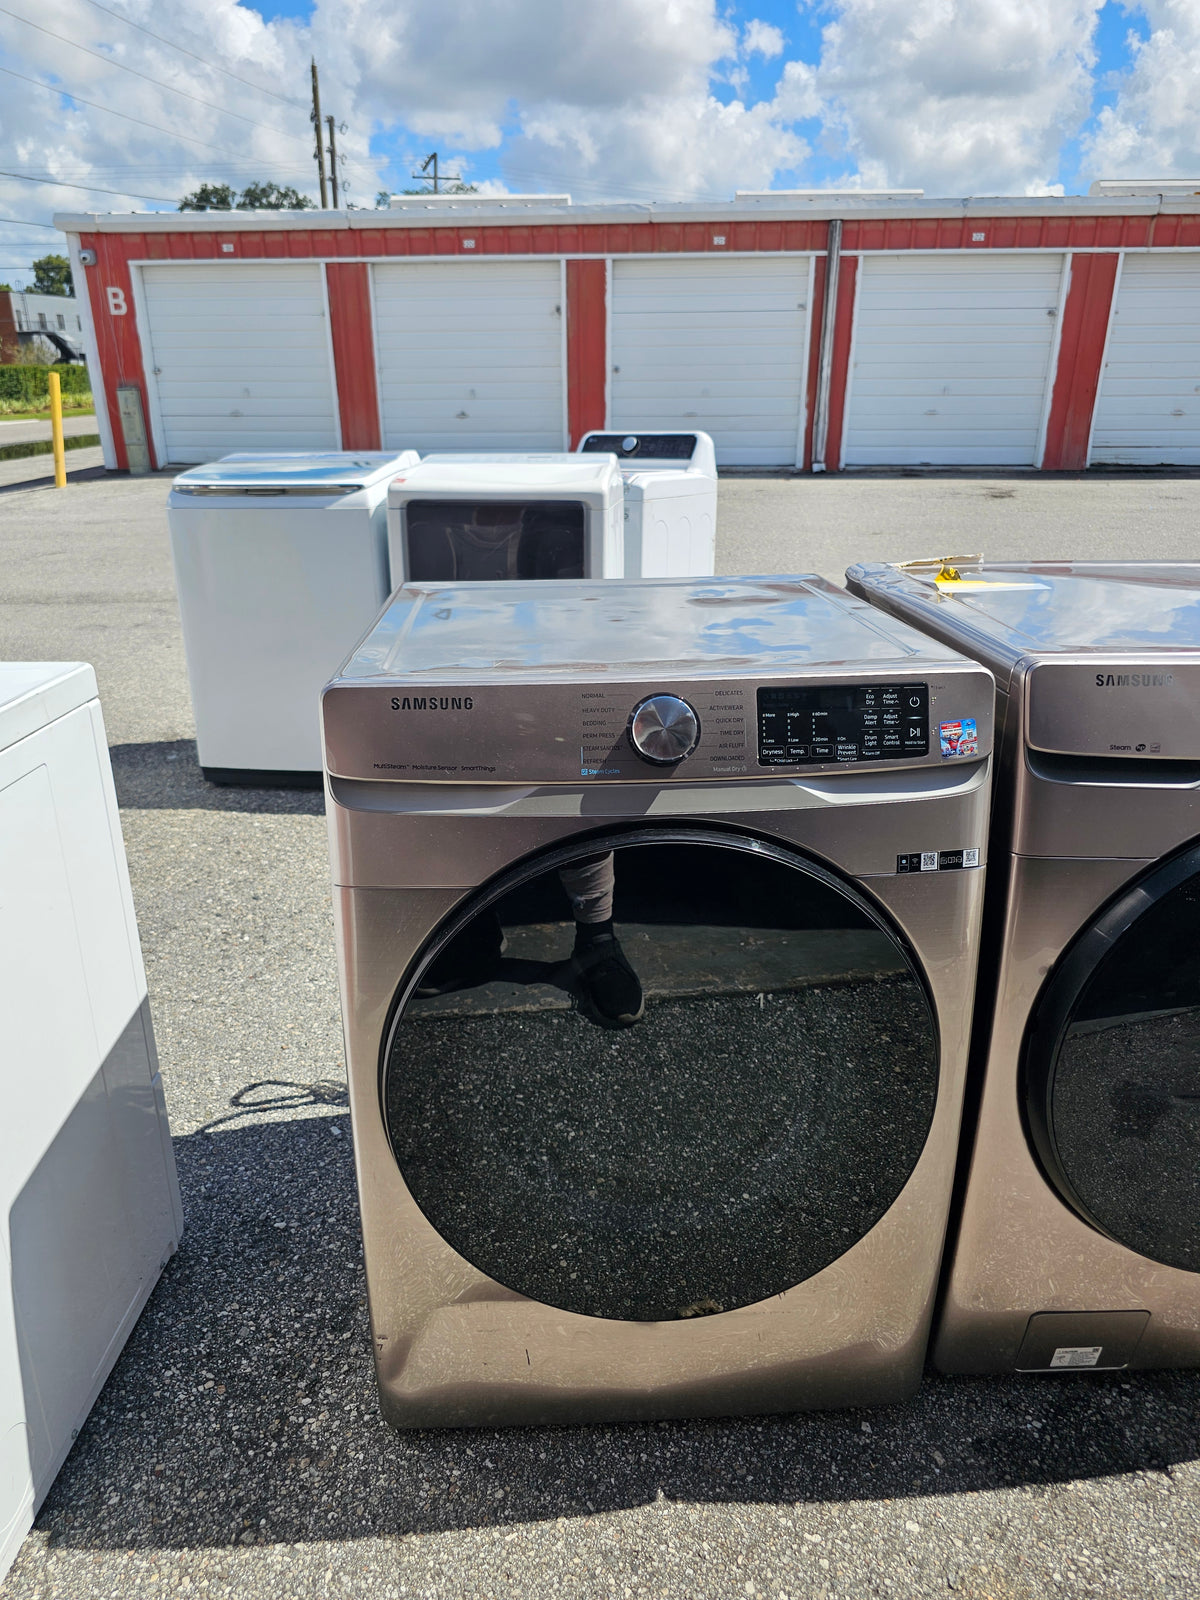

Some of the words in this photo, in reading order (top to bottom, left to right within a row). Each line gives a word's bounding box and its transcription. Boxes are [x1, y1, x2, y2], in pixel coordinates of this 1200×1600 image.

[106, 287, 127, 315] B
[1096, 674, 1174, 686] SAMSUNG
[391, 697, 473, 710] SAMSUNG
